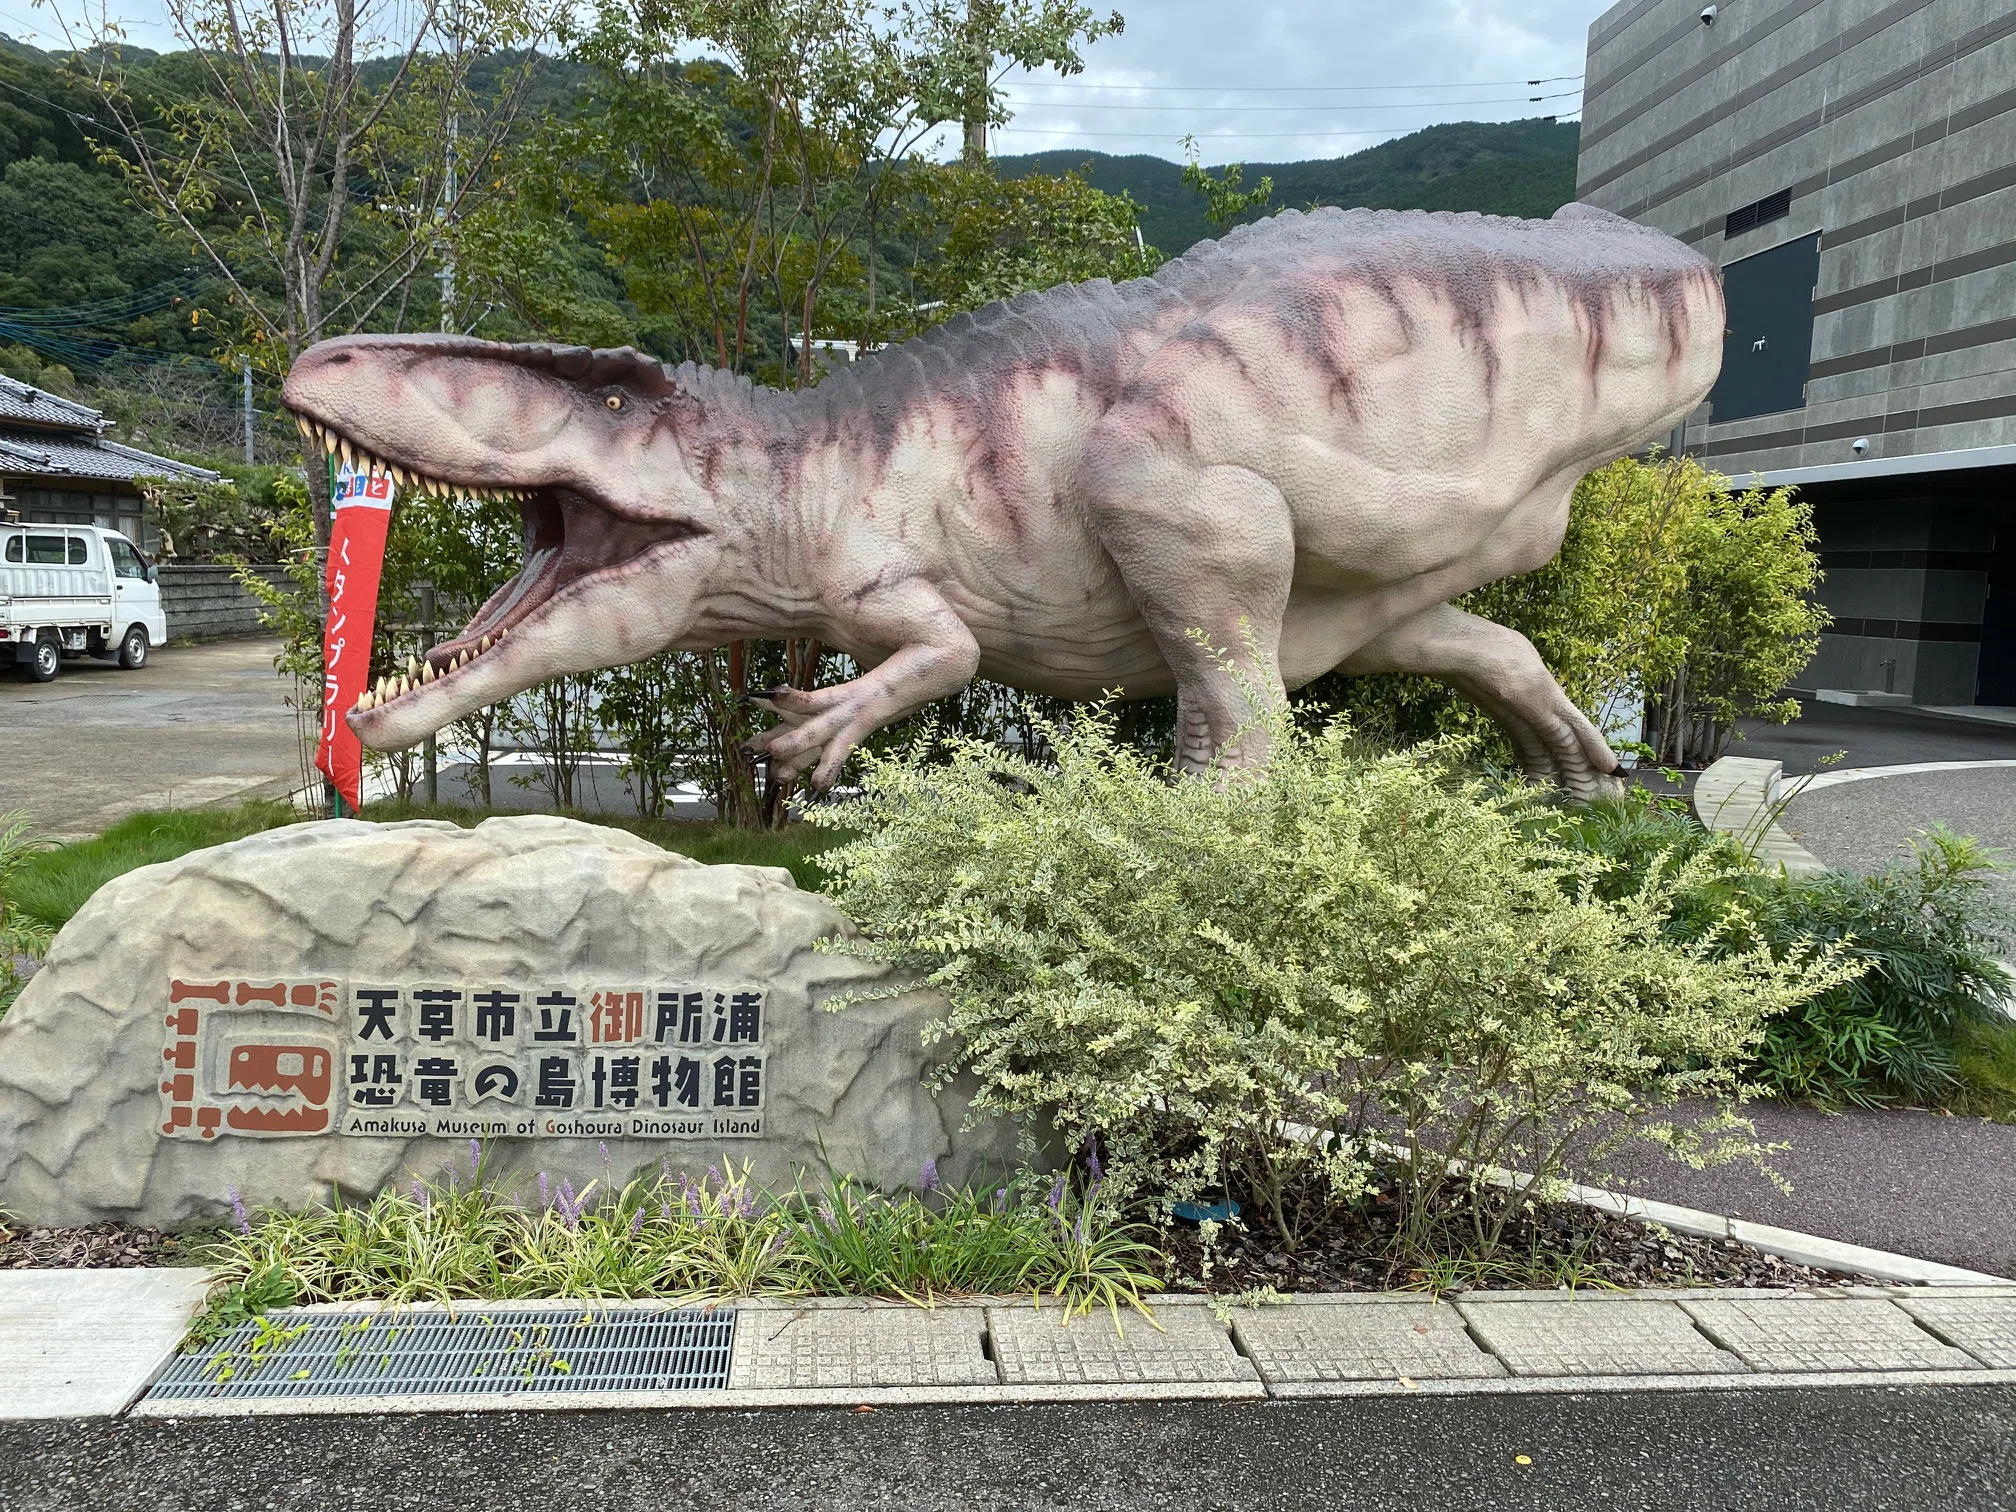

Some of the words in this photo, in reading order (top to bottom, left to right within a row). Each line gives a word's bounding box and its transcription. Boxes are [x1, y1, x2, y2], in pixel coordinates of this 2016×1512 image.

[356, 990, 763, 1044] 天草市立御所浦
[351, 1055, 763, 1109] 恐竜の島博物館
[350, 1117, 426, 1133] Amakusa
[436, 1119, 507, 1134] Museum
[516, 1118, 535, 1134] of
[546, 1119, 622, 1134] Goshoura
[632, 1119, 704, 1134] Dinosaur
[713, 1119, 760, 1134] Island
